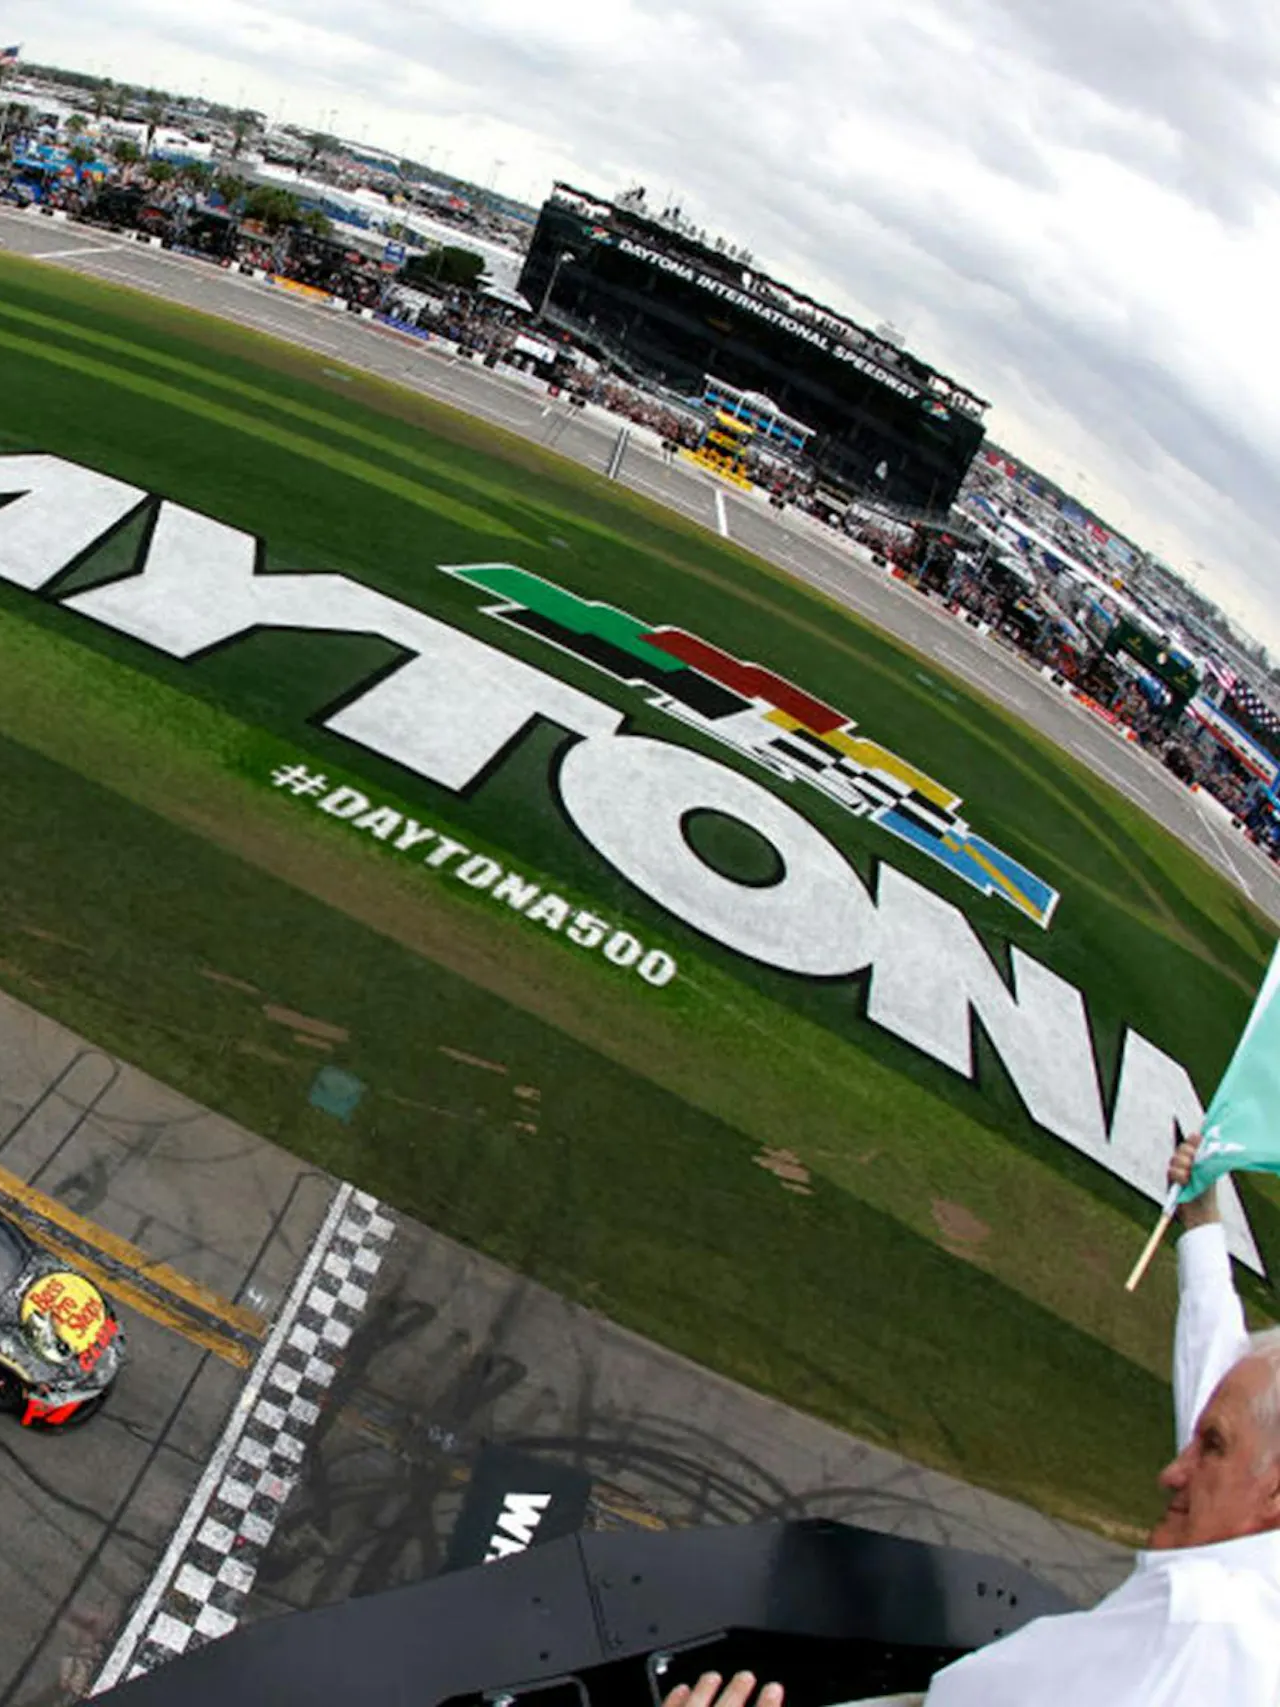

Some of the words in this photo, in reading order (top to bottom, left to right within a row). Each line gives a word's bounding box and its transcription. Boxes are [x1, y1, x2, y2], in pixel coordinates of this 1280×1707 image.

[619, 239, 693, 282] DAYTONA
[696, 272, 829, 351] INTERNATIONAL
[833, 344, 920, 400] SPEEDWAY
[269, 763, 678, 988] #DAYTONA500
[30, 1278, 65, 1316] Bass
[50, 1296, 78, 1325] Pro
[67, 1297, 102, 1340] Shops
